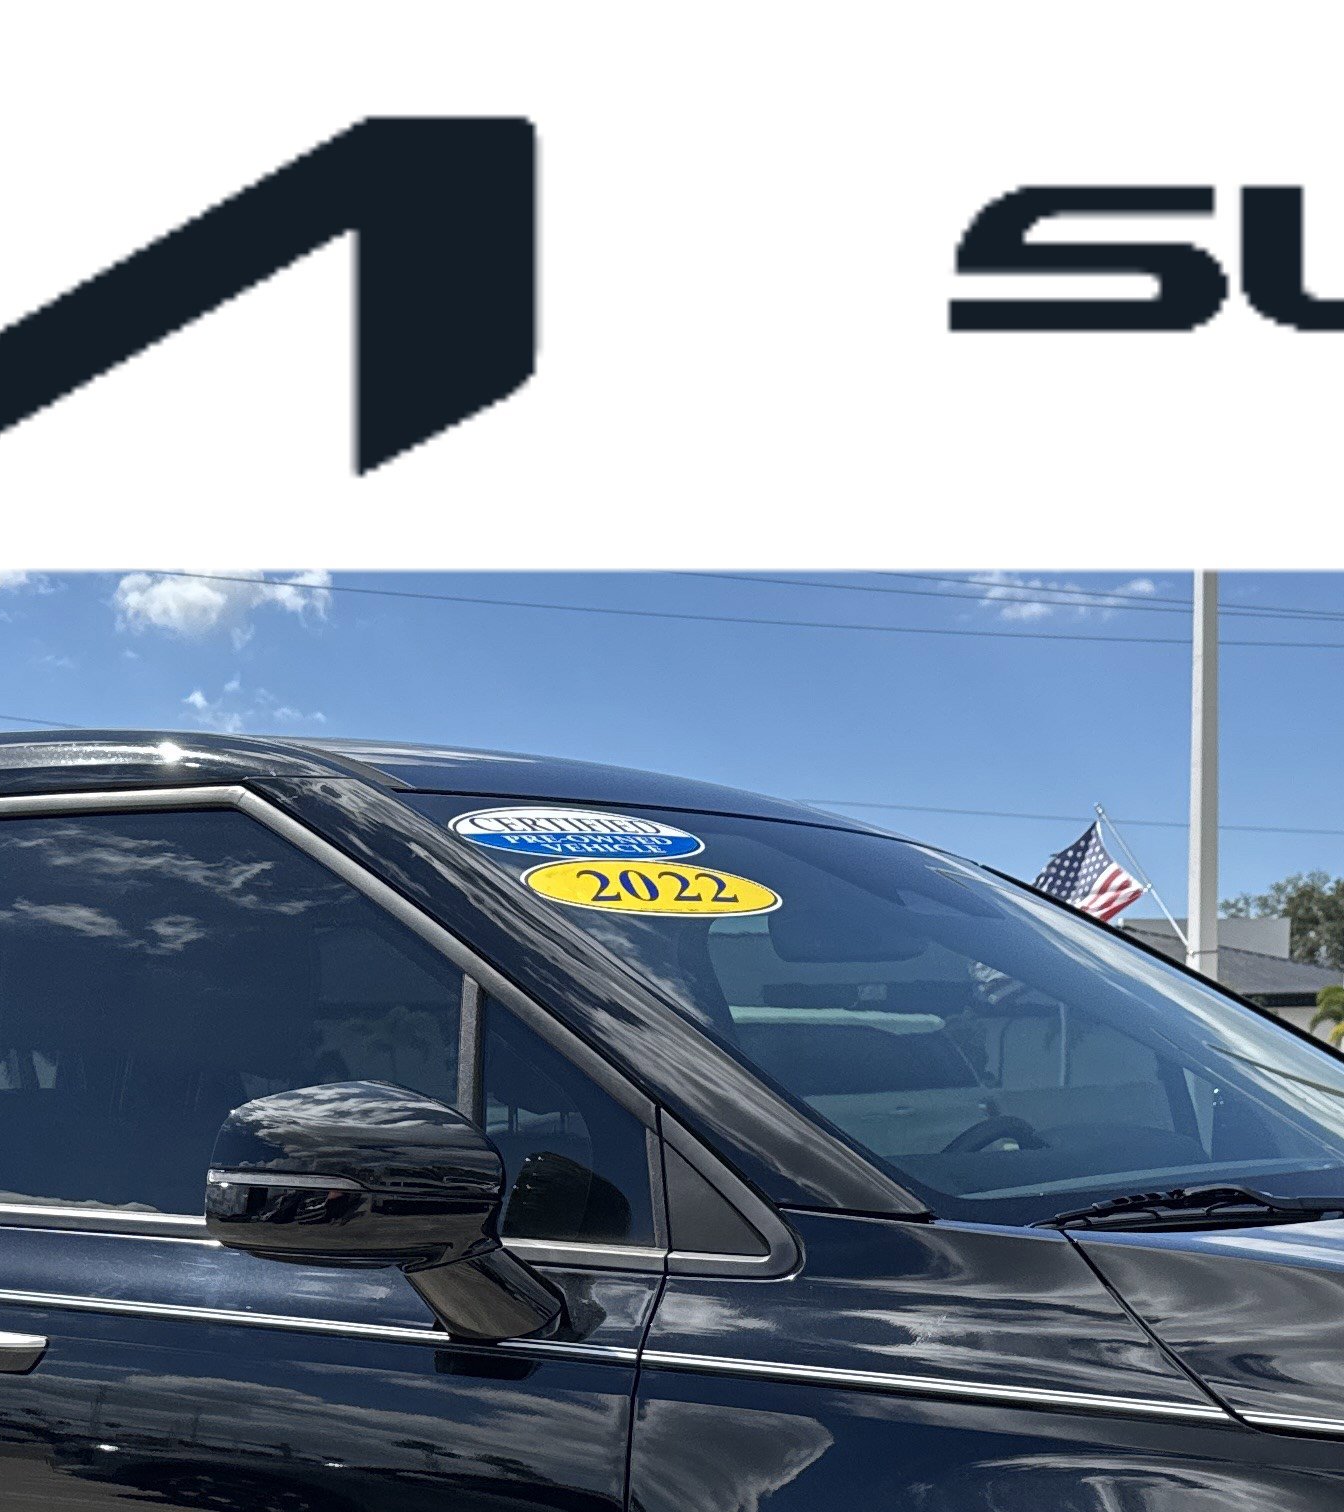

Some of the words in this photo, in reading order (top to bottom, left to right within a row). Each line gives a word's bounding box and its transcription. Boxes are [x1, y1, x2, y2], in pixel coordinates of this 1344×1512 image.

[469, 817, 662, 834] CERTIFIED
[503, 834, 673, 847] PRE-OWNED
[545, 842, 668, 854] VEHICLE
[576, 869, 739, 902] 2022
